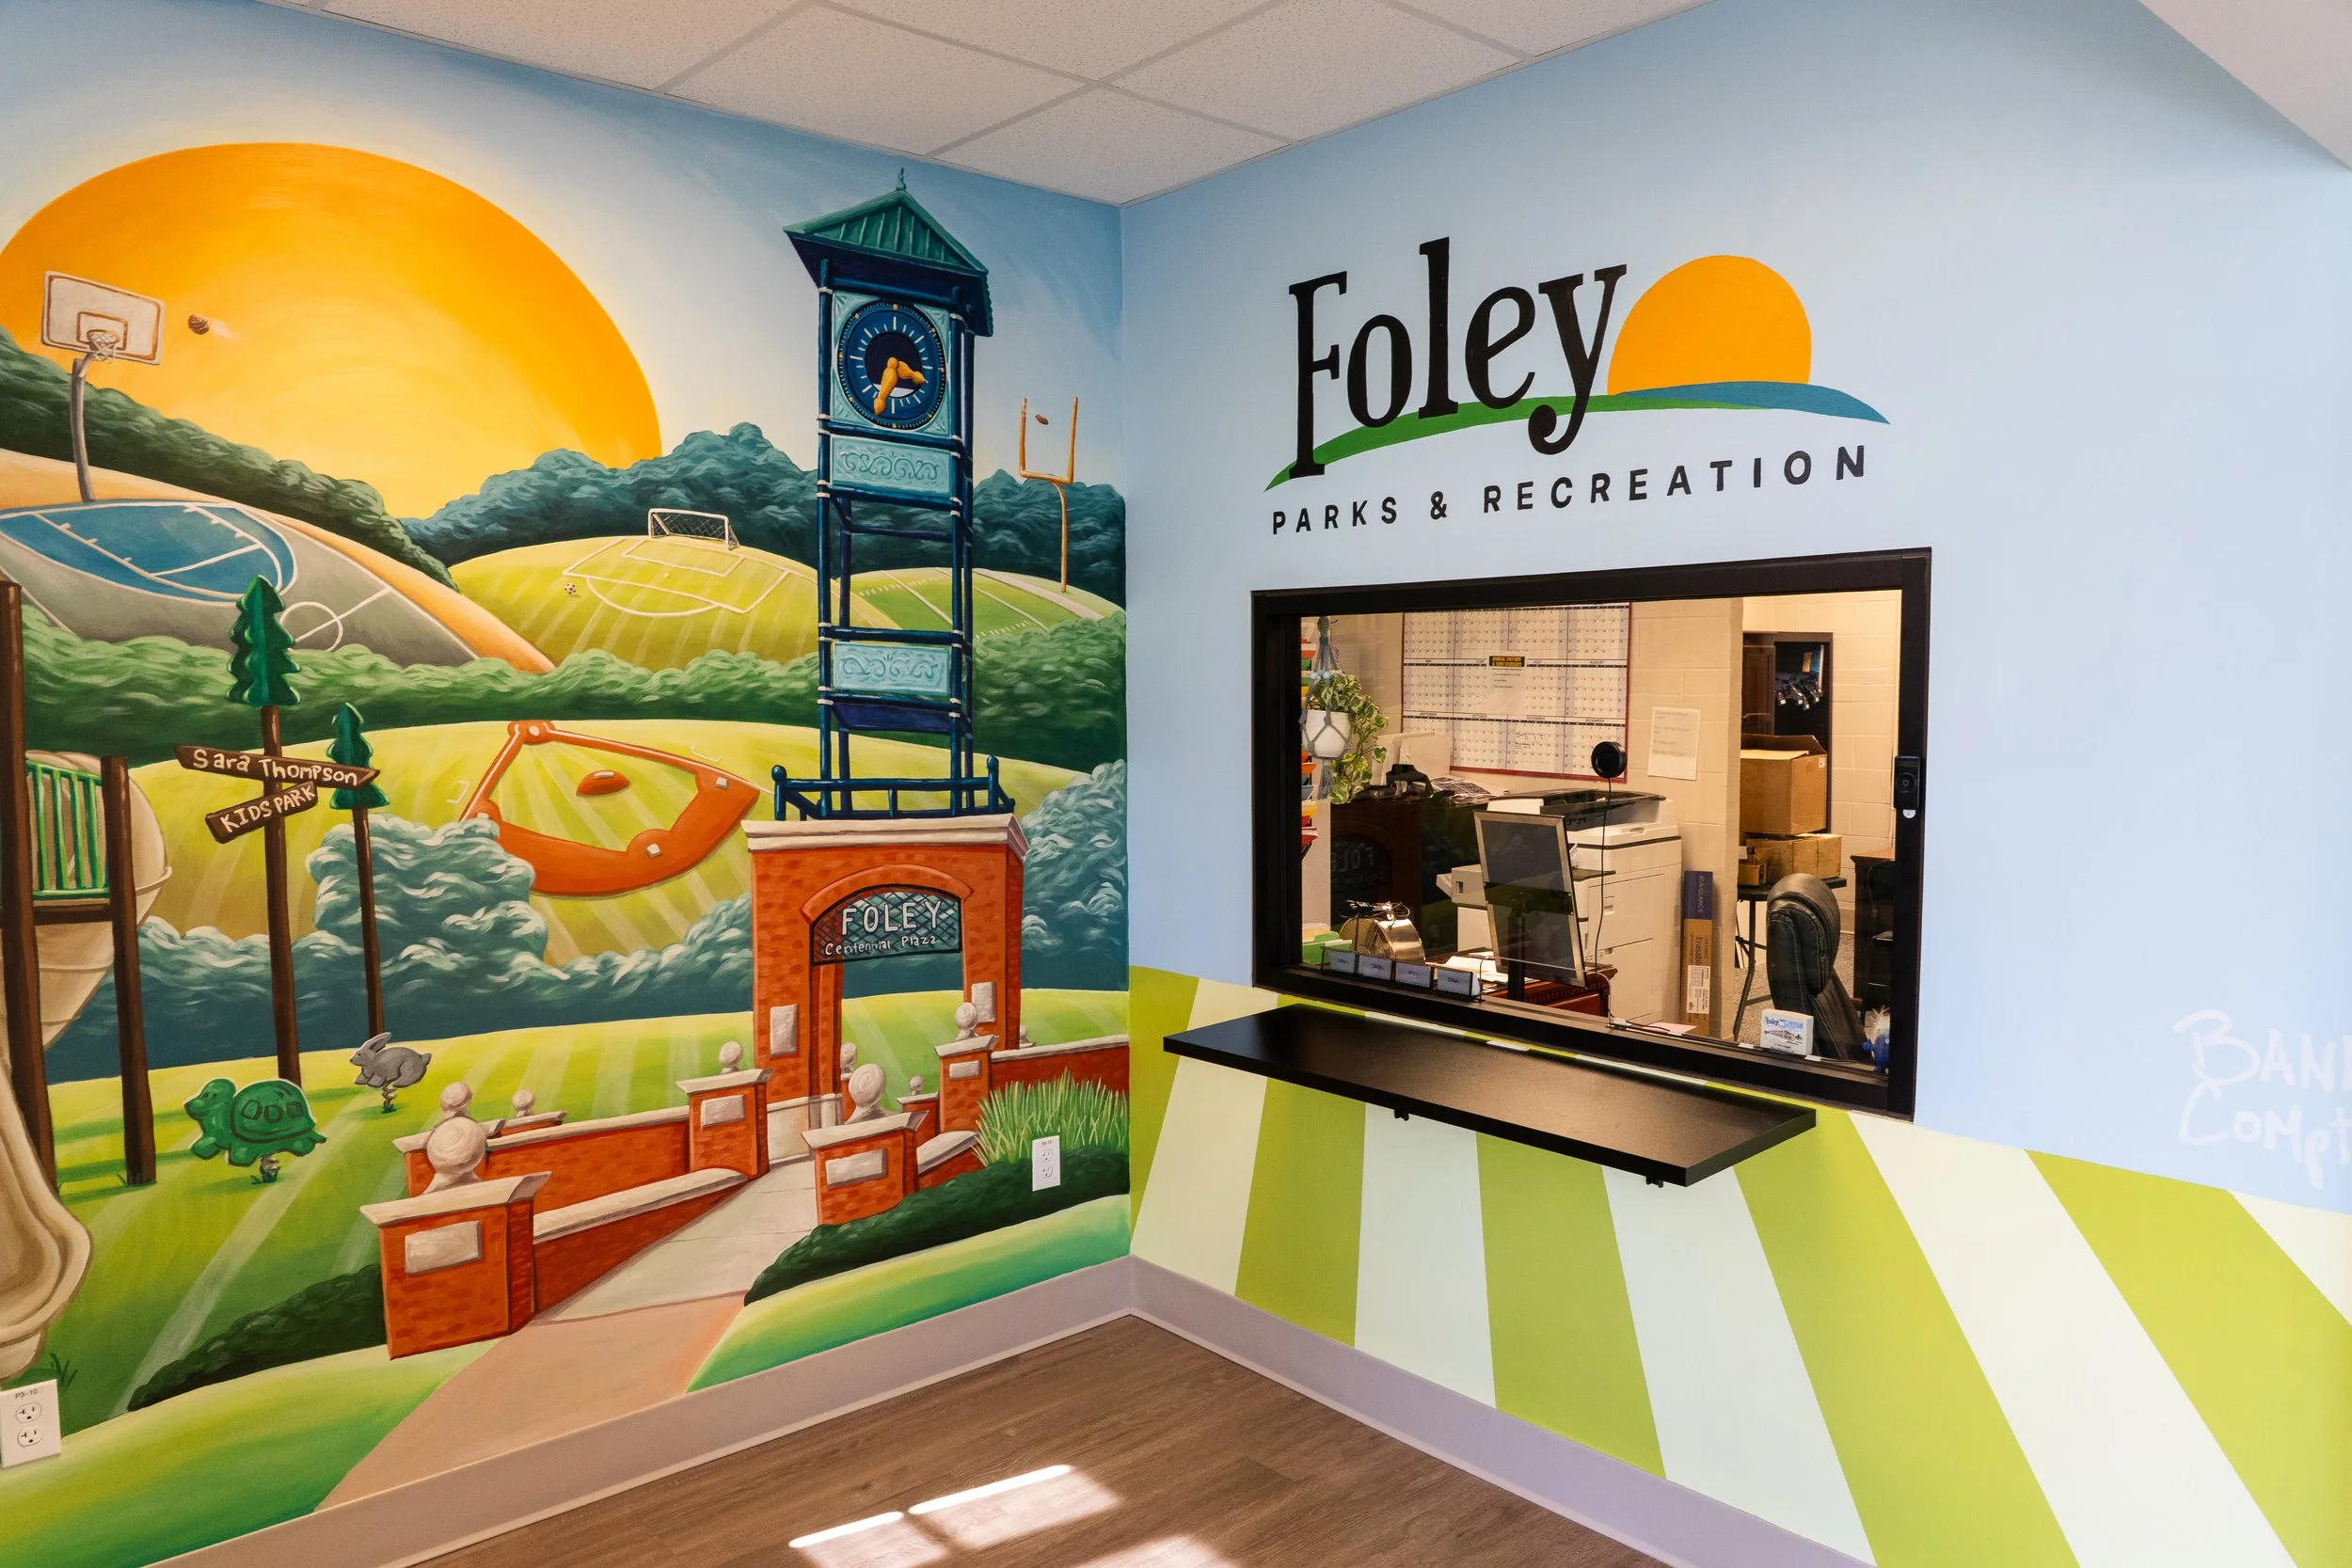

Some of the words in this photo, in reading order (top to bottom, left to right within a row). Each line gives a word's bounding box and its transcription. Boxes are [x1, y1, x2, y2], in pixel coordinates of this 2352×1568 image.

[1289, 236, 1627, 480] Foley
[1272, 496, 1398, 535] PARKS
[1429, 490, 1448, 520] &
[1483, 444, 1866, 514] RECREATION
[193, 749, 250, 773] Sara
[258, 758, 358, 786] Thompson
[220, 800, 273, 833] KIDS
[274, 784, 317, 814] PARK
[842, 900, 941, 936] FOLEY
[825, 941, 891, 956] Centennial
[901, 935, 937, 947] Plaza
[1695, 936, 1704, 966] Erasabl
